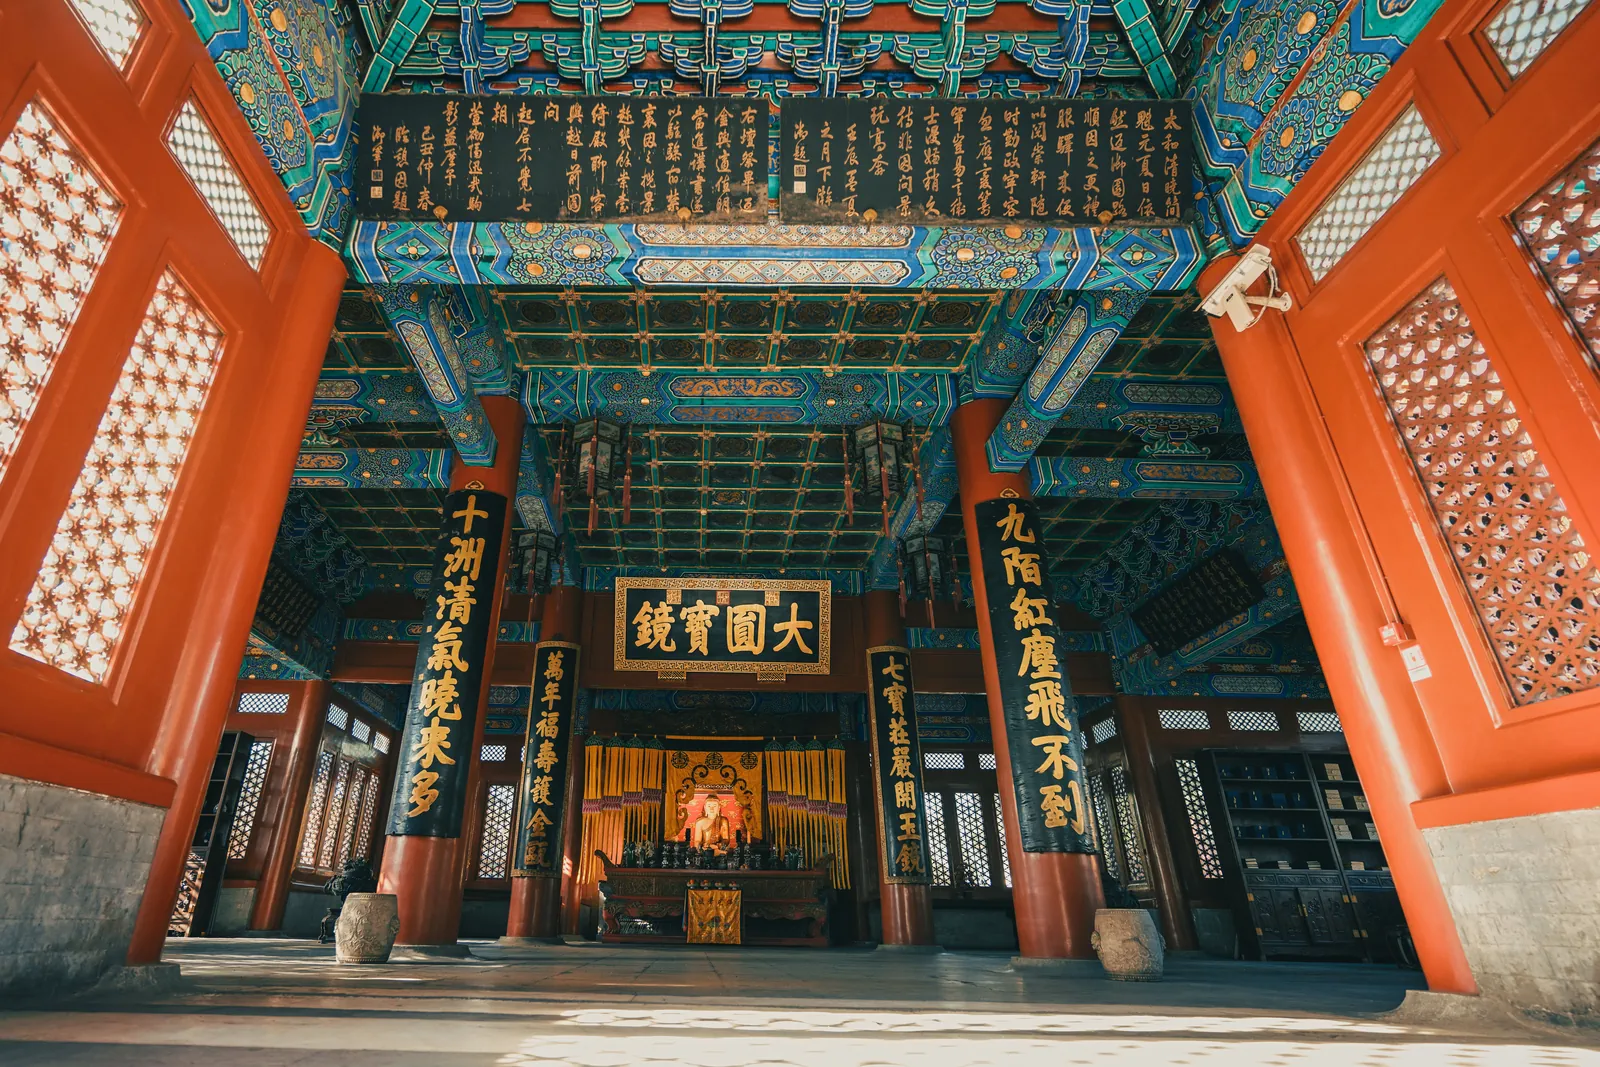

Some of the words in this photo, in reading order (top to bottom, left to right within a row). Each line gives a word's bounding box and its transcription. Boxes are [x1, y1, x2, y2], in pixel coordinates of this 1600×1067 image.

[996, 503, 1086, 835] 九陌紅塵飛不到
